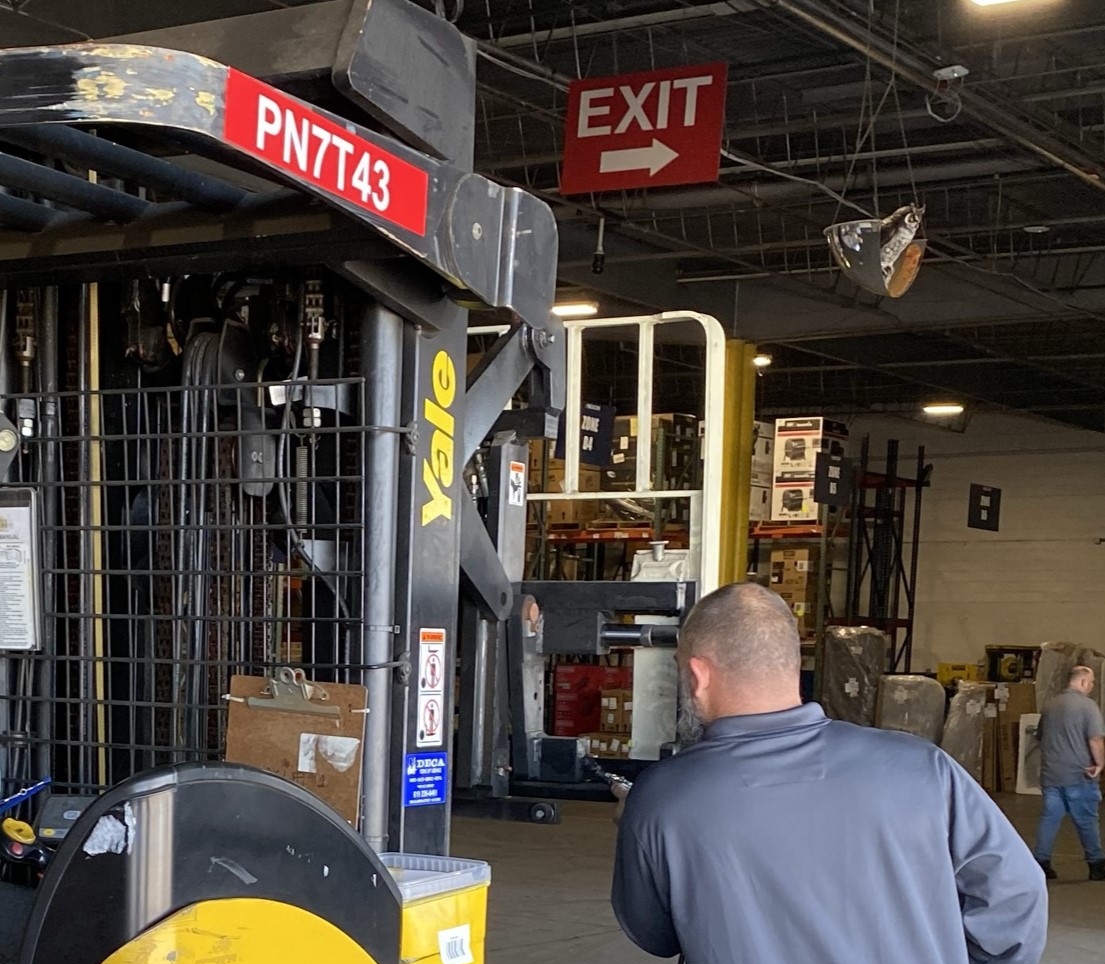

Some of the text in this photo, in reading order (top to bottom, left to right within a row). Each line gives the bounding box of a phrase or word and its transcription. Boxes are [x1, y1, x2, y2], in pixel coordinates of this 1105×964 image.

[577, 75, 713, 138] EXIT
[256, 93, 391, 212] PN7T43
[422, 350, 456, 527] Yale
[416, 758, 445, 767] DECA
